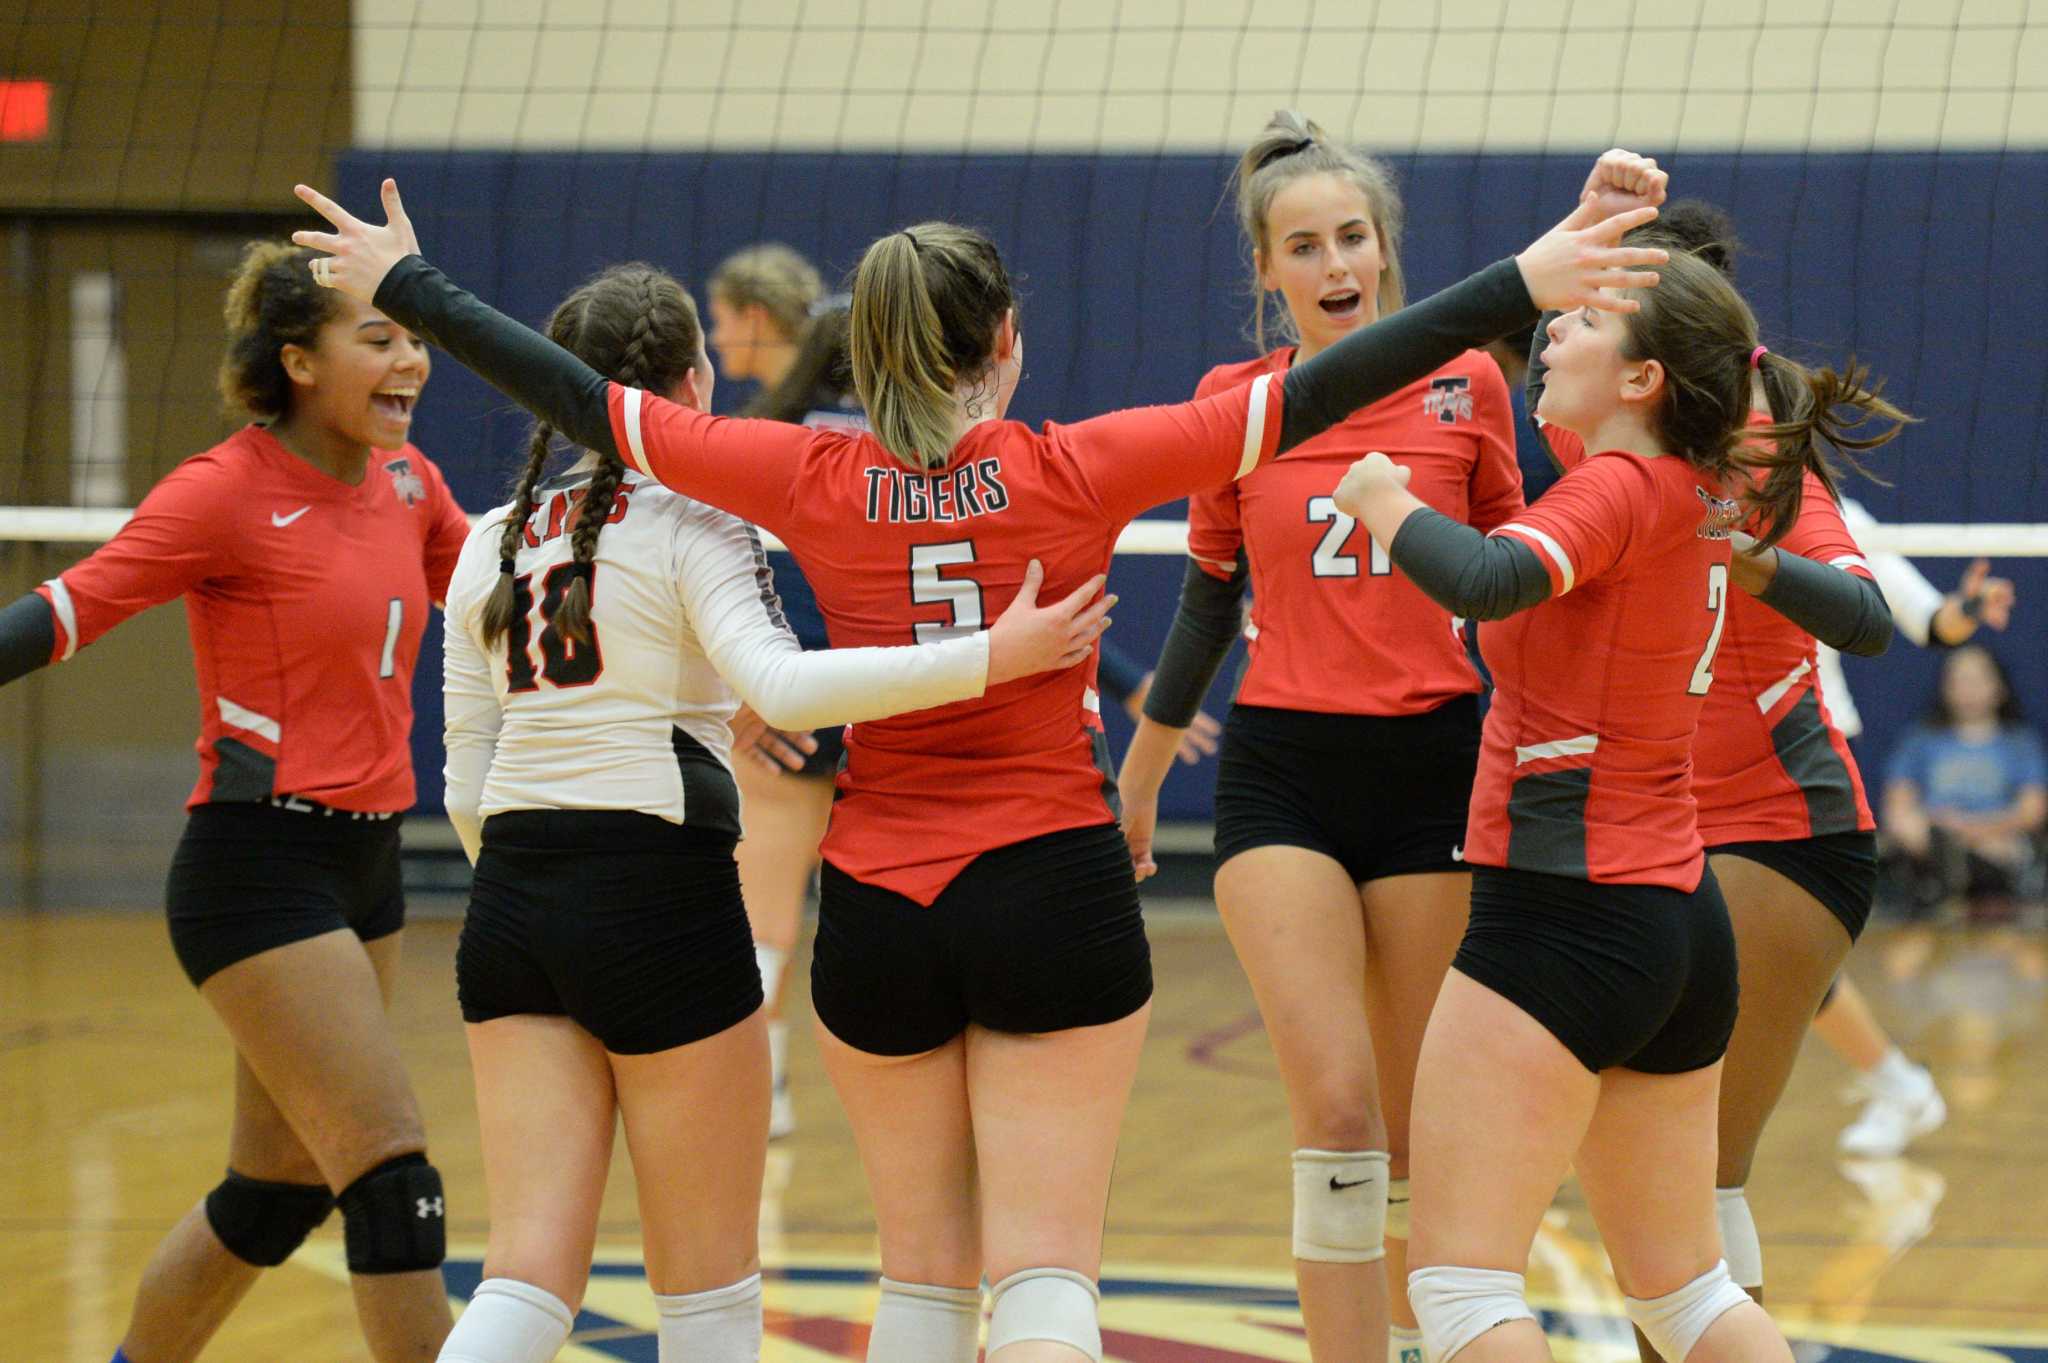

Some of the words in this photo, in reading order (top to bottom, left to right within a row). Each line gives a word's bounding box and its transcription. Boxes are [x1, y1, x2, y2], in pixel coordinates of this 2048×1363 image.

[1431, 376, 1471, 425] T
[864, 457, 1009, 523] TIGERS
[909, 538, 985, 645] 5
[1686, 563, 1728, 696] 2
[379, 597, 403, 679] 1
